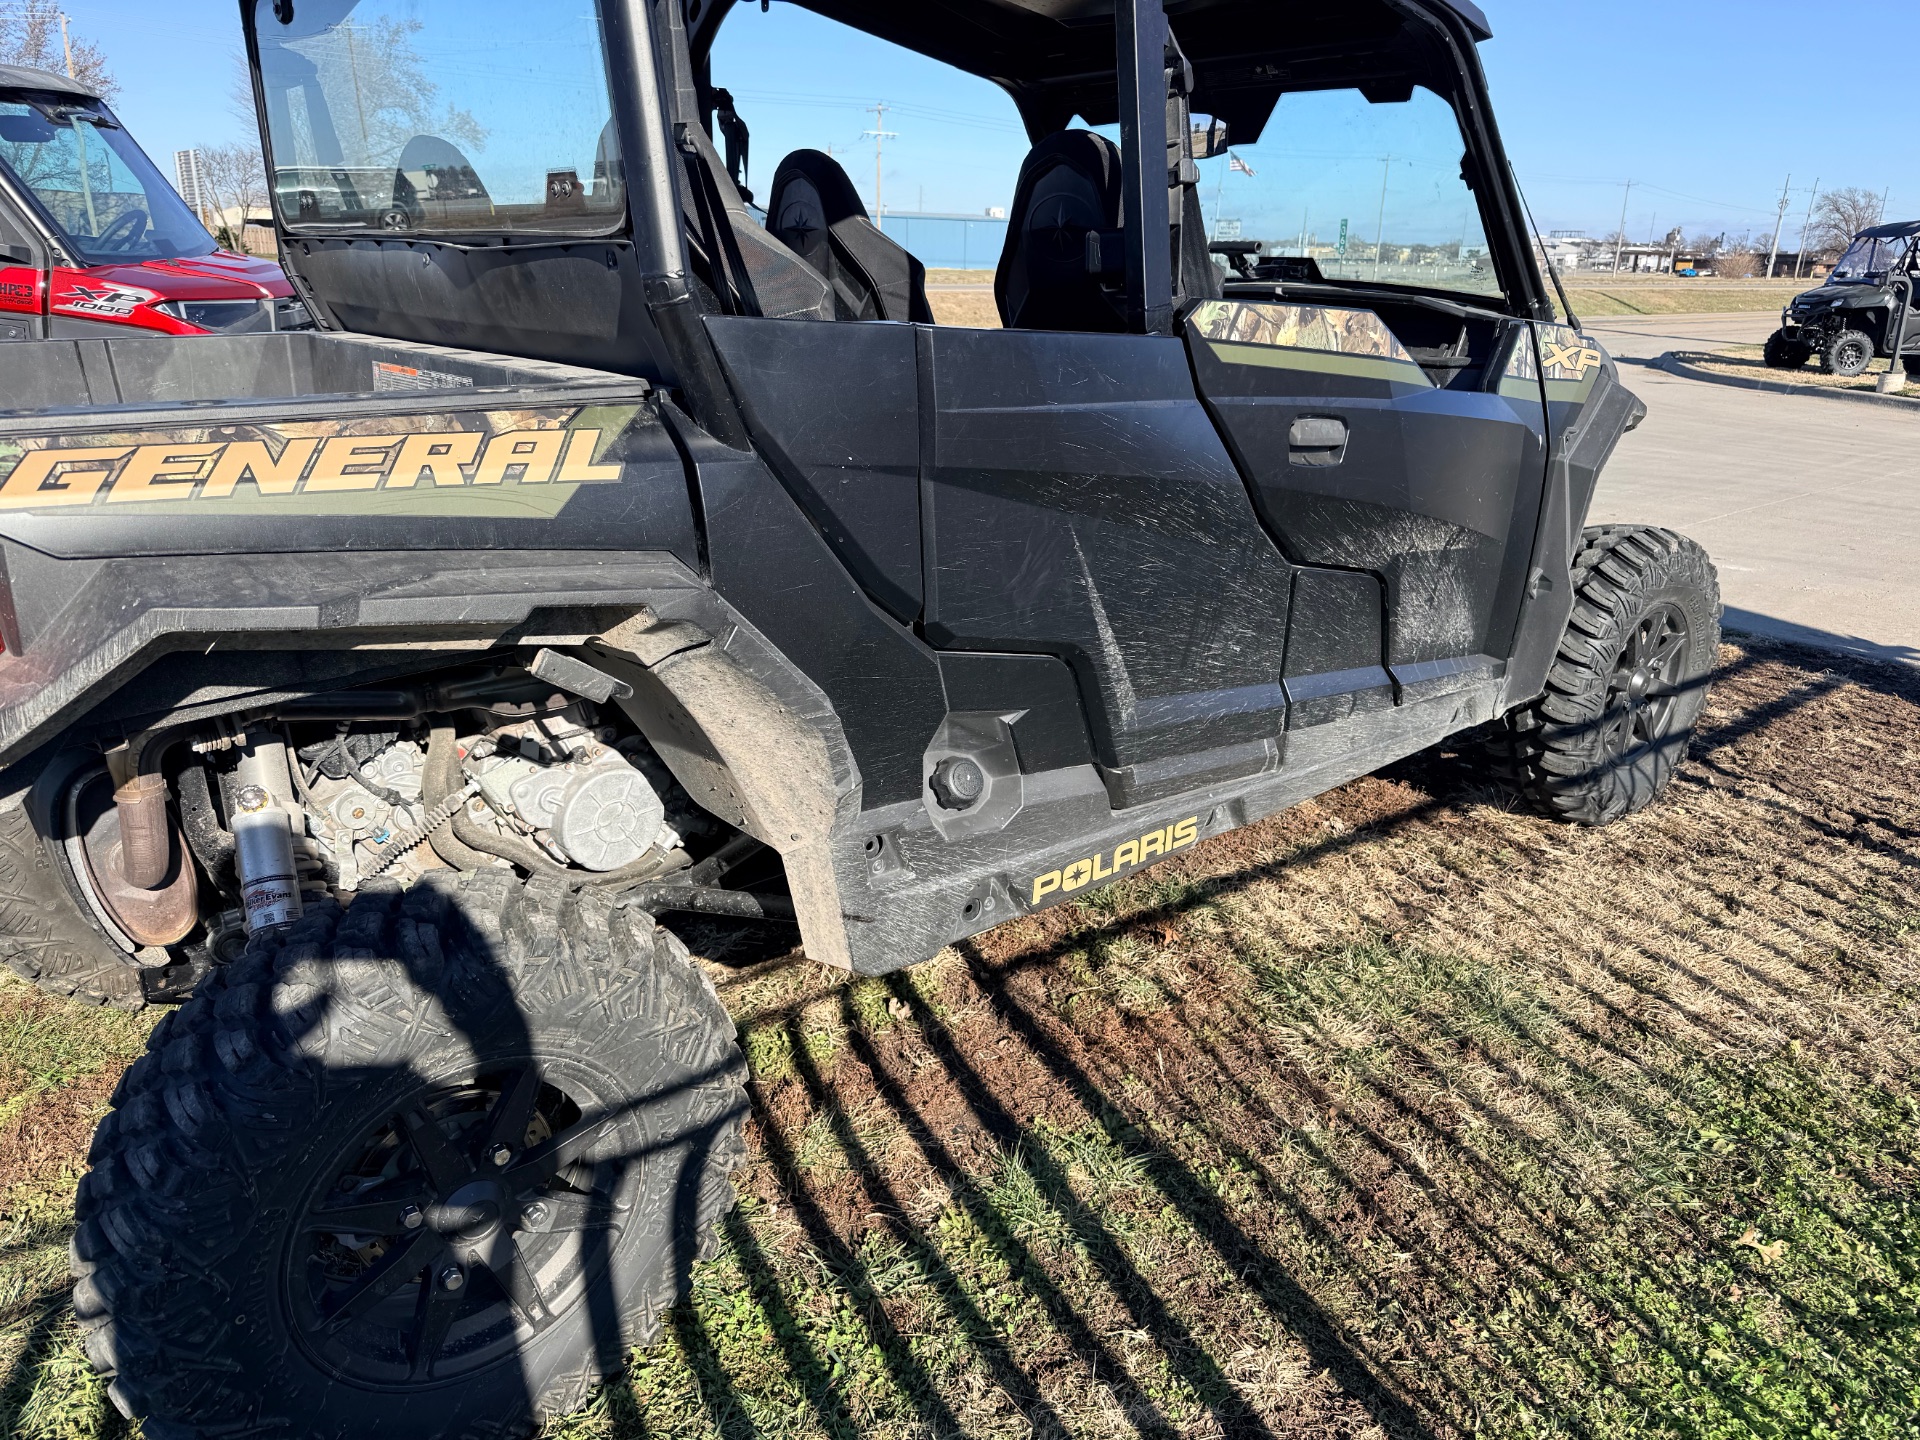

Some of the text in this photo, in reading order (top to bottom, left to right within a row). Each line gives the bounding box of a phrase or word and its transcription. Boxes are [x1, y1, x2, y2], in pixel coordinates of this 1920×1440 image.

[60, 285, 147, 303] XP
[73, 300, 134, 315] 1000
[1541, 341, 1601, 371] XP
[0, 427, 623, 509] GENERAL
[1031, 815, 1198, 906] POLARIS
[265, 891, 292, 901] Evans
